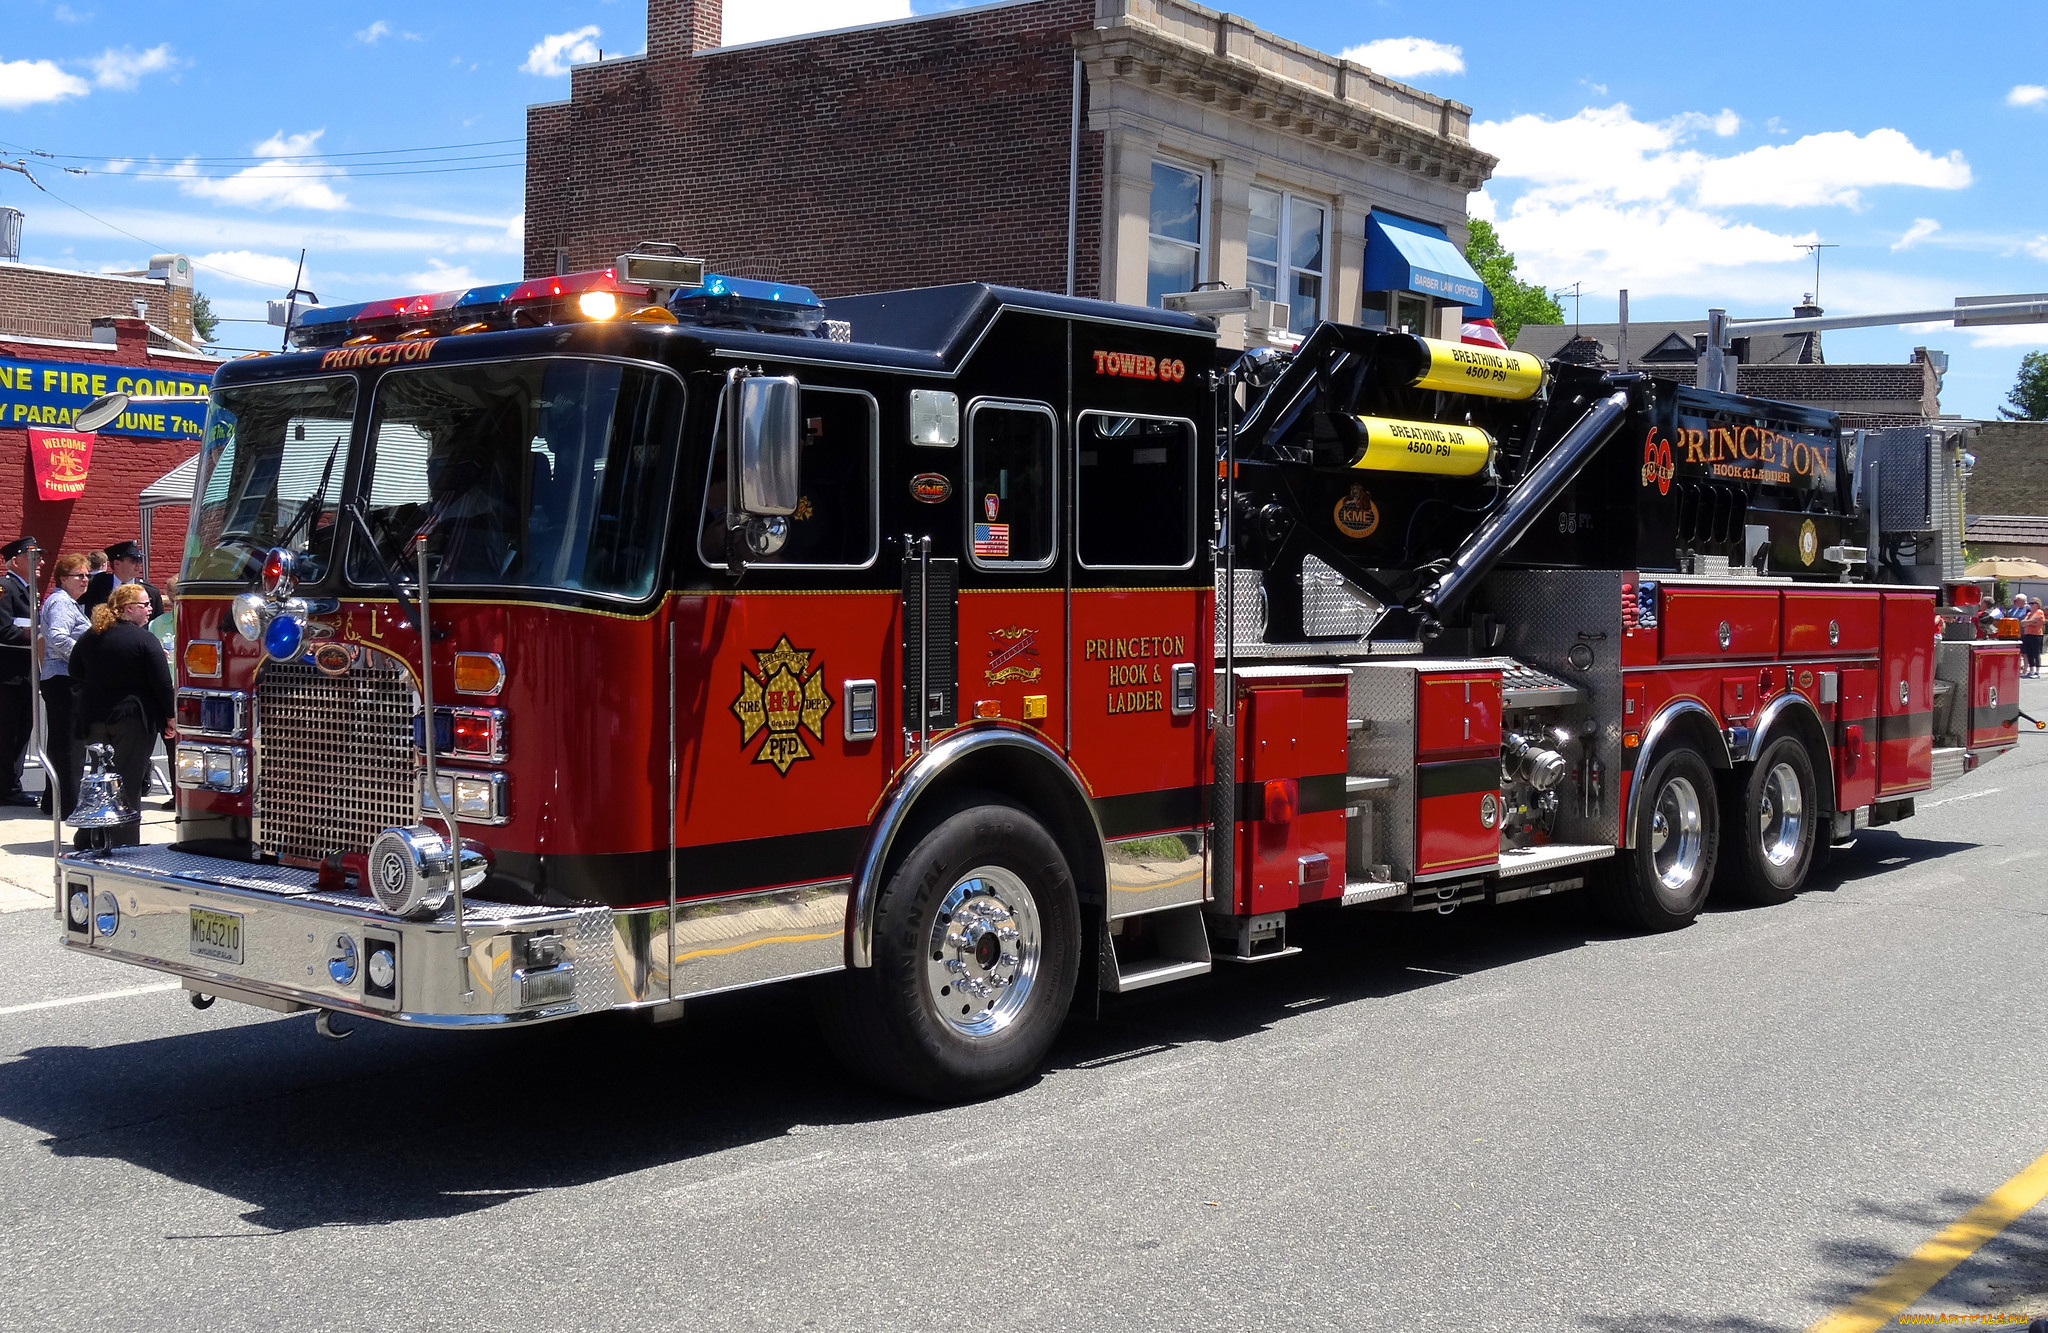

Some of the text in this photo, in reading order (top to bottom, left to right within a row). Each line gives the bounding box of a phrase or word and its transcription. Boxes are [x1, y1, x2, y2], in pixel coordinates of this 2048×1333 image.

[1414, 273, 1479, 299] BARBER LAW OFFICES
[320, 339, 440, 370] PRINCETON
[1093, 350, 1185, 383] TOWER 60
[1451, 348, 1521, 372] BREATHING AIR
[43, 370, 107, 396] FIRE
[1465, 366, 1507, 382] 4500 PSI
[115, 412, 166, 432] JUNE
[170, 415, 204, 438] 7th,
[1389, 424, 1465, 446] BREATHING AIR
[42, 437, 87, 451] WELCOME
[1407, 441, 1451, 457] 4500 PSI
[1644, 426, 1672, 496] 60
[1713, 463, 1742, 478] HOOK
[1751, 468, 1791, 483] LADDER
[917, 485, 944, 495] KME
[1343, 510, 1371, 523] KME
[1558, 511, 1577, 534] 95
[1085, 636, 1185, 661] PRINCETON
[1109, 663, 1163, 687] HOOK &
[738, 700, 761, 713] FIRE
[768, 691, 800, 712] H&L
[805, 698, 828, 710] DEPT.
[1107, 690, 1163, 714] LADDER
[769, 738, 799, 764] PFD
[192, 918, 239, 950] MG45210
